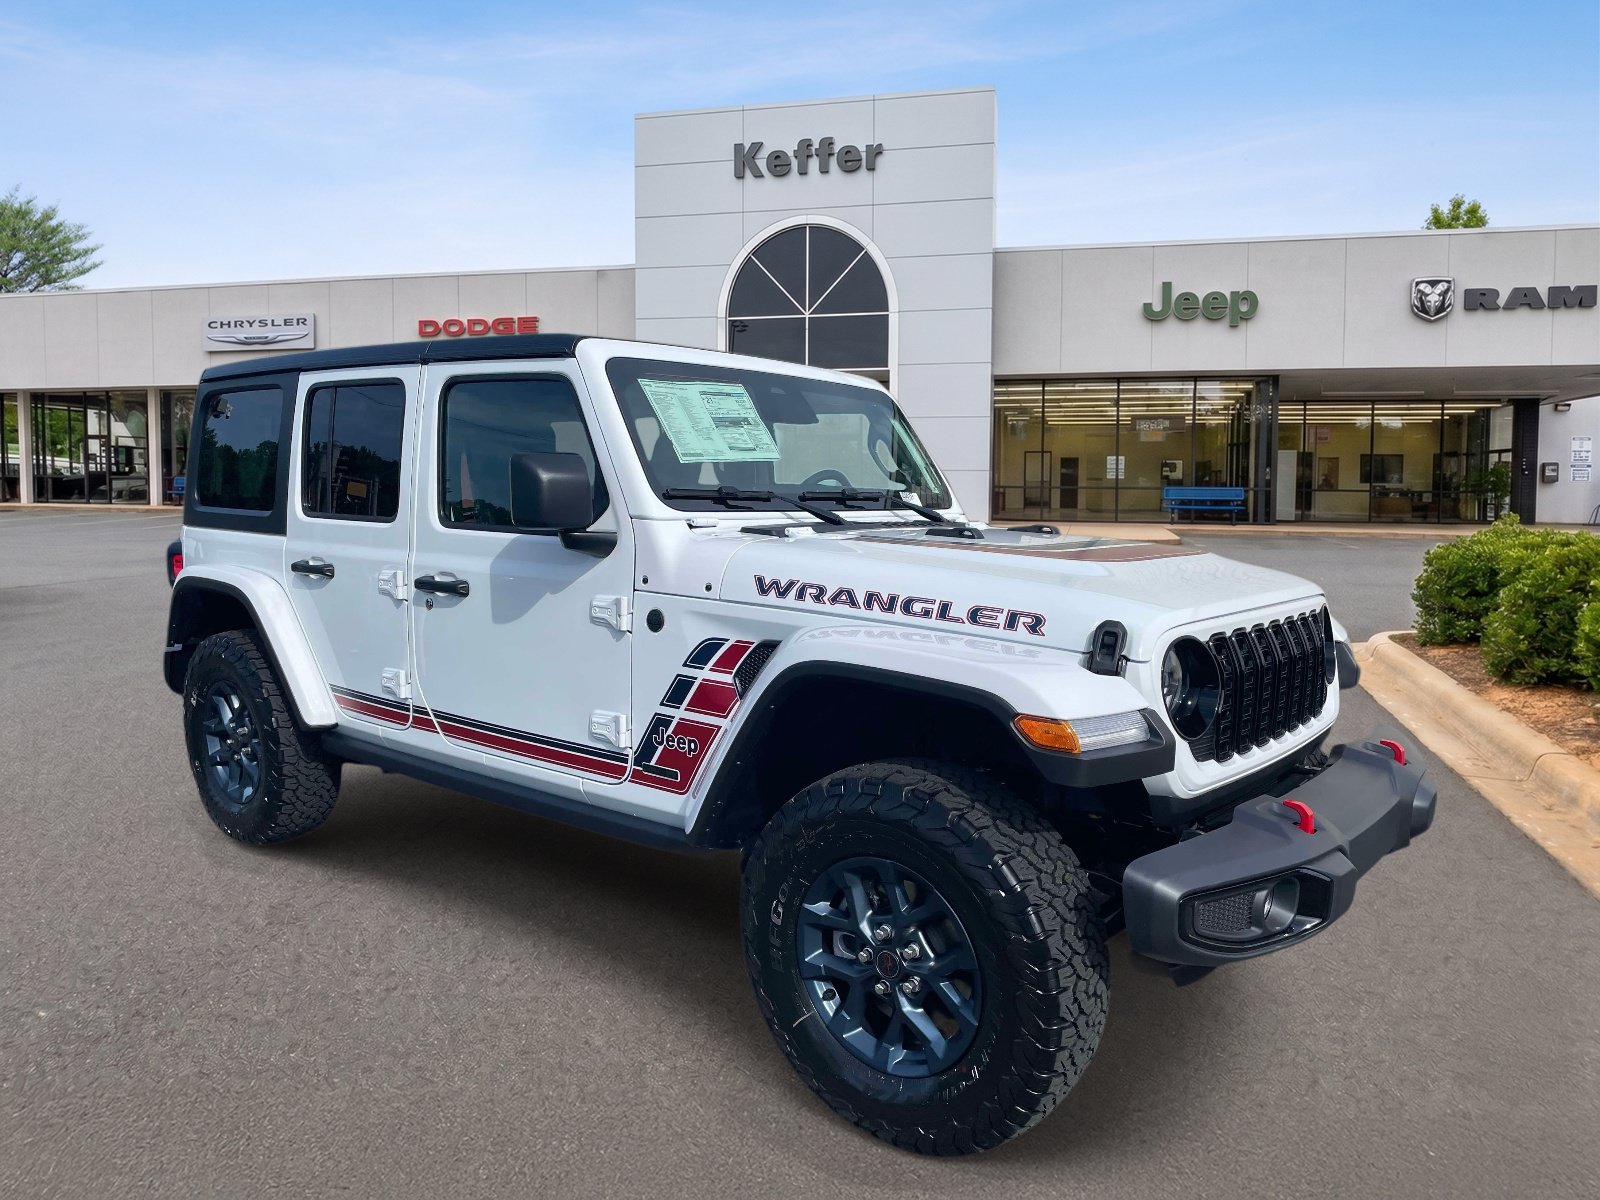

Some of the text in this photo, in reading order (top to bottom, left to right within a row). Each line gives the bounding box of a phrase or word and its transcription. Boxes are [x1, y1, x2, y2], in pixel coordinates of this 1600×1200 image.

[733, 136, 883, 179] Keffer
[1142, 281, 1259, 327] Jeep
[1463, 284, 1598, 310] RAM
[207, 317, 308, 329] CHRYSLER
[418, 316, 540, 337] DODGE
[753, 574, 1047, 637] WRANGLER
[652, 726, 700, 758] Jeep
